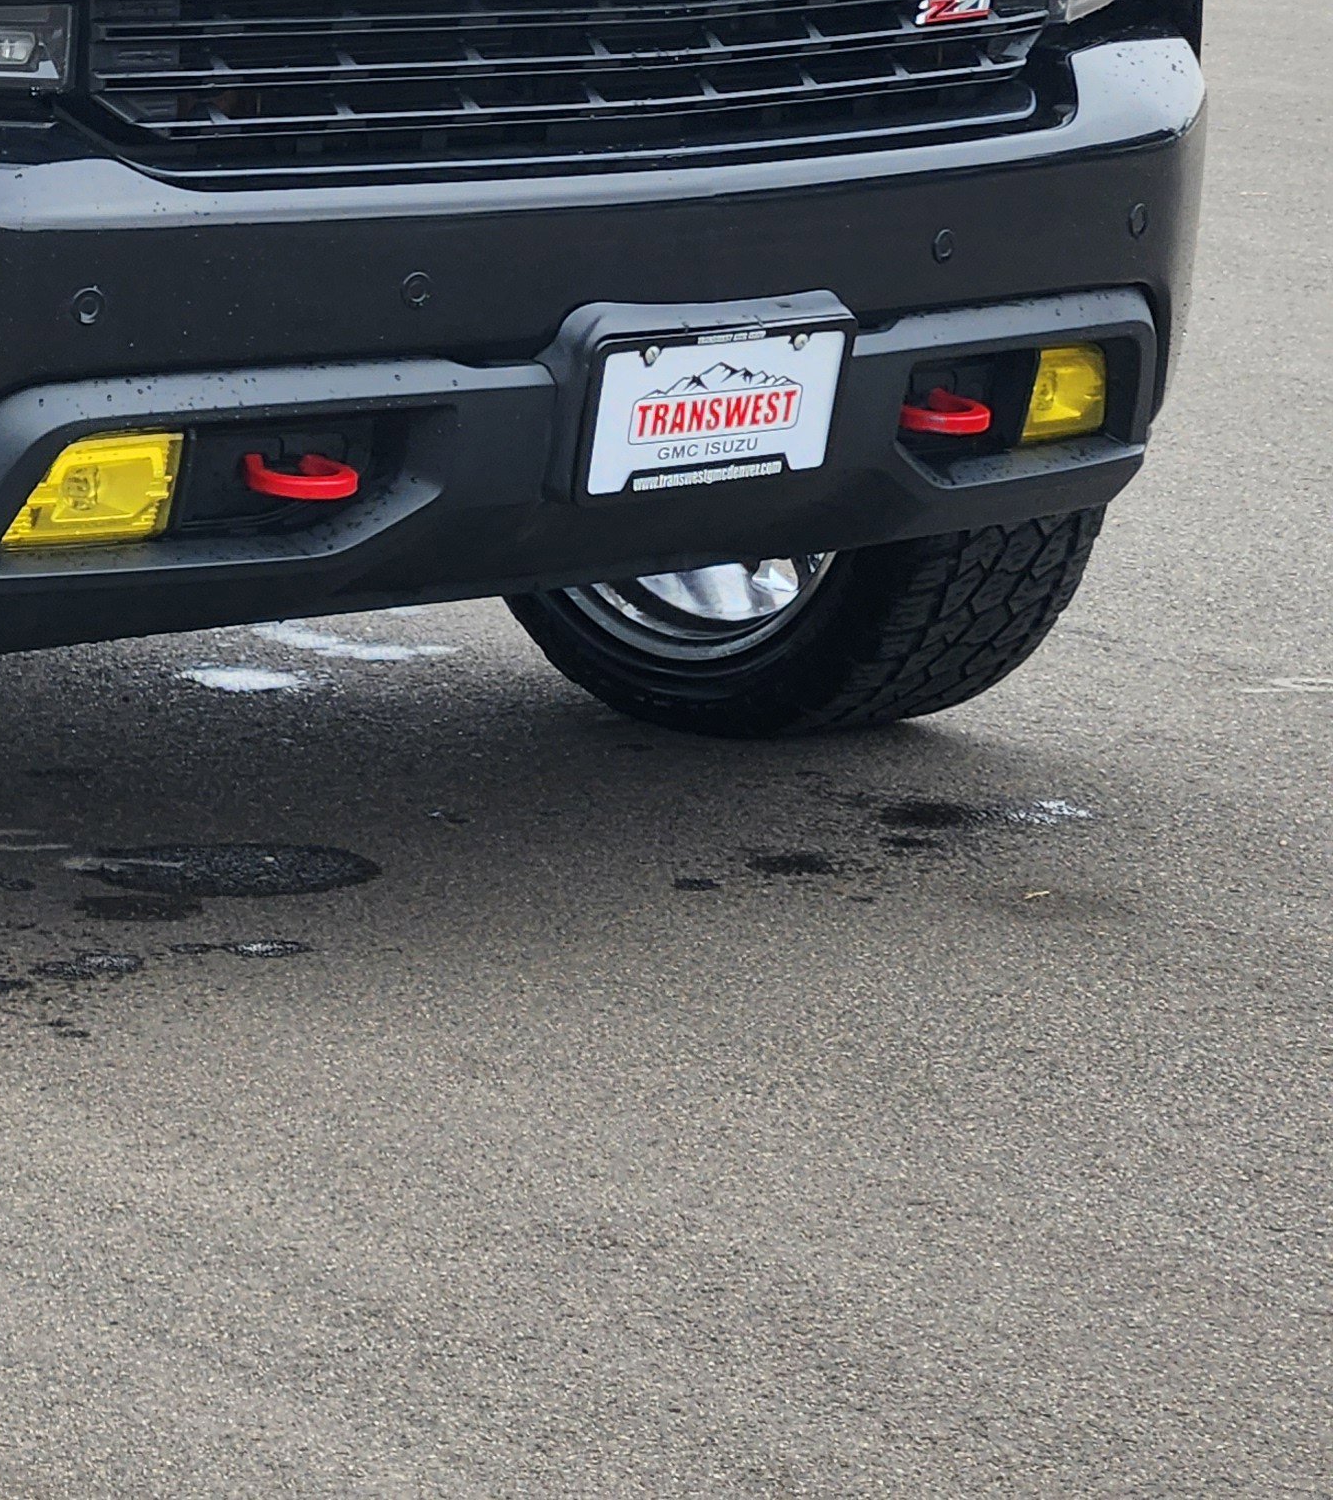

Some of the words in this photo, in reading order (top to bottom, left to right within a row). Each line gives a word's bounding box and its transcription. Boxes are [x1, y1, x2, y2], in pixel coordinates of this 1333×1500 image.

[636, 389, 798, 438] TRANSWEST
[656, 443, 699, 461] GMC
[704, 437, 759, 455] ISUZU
